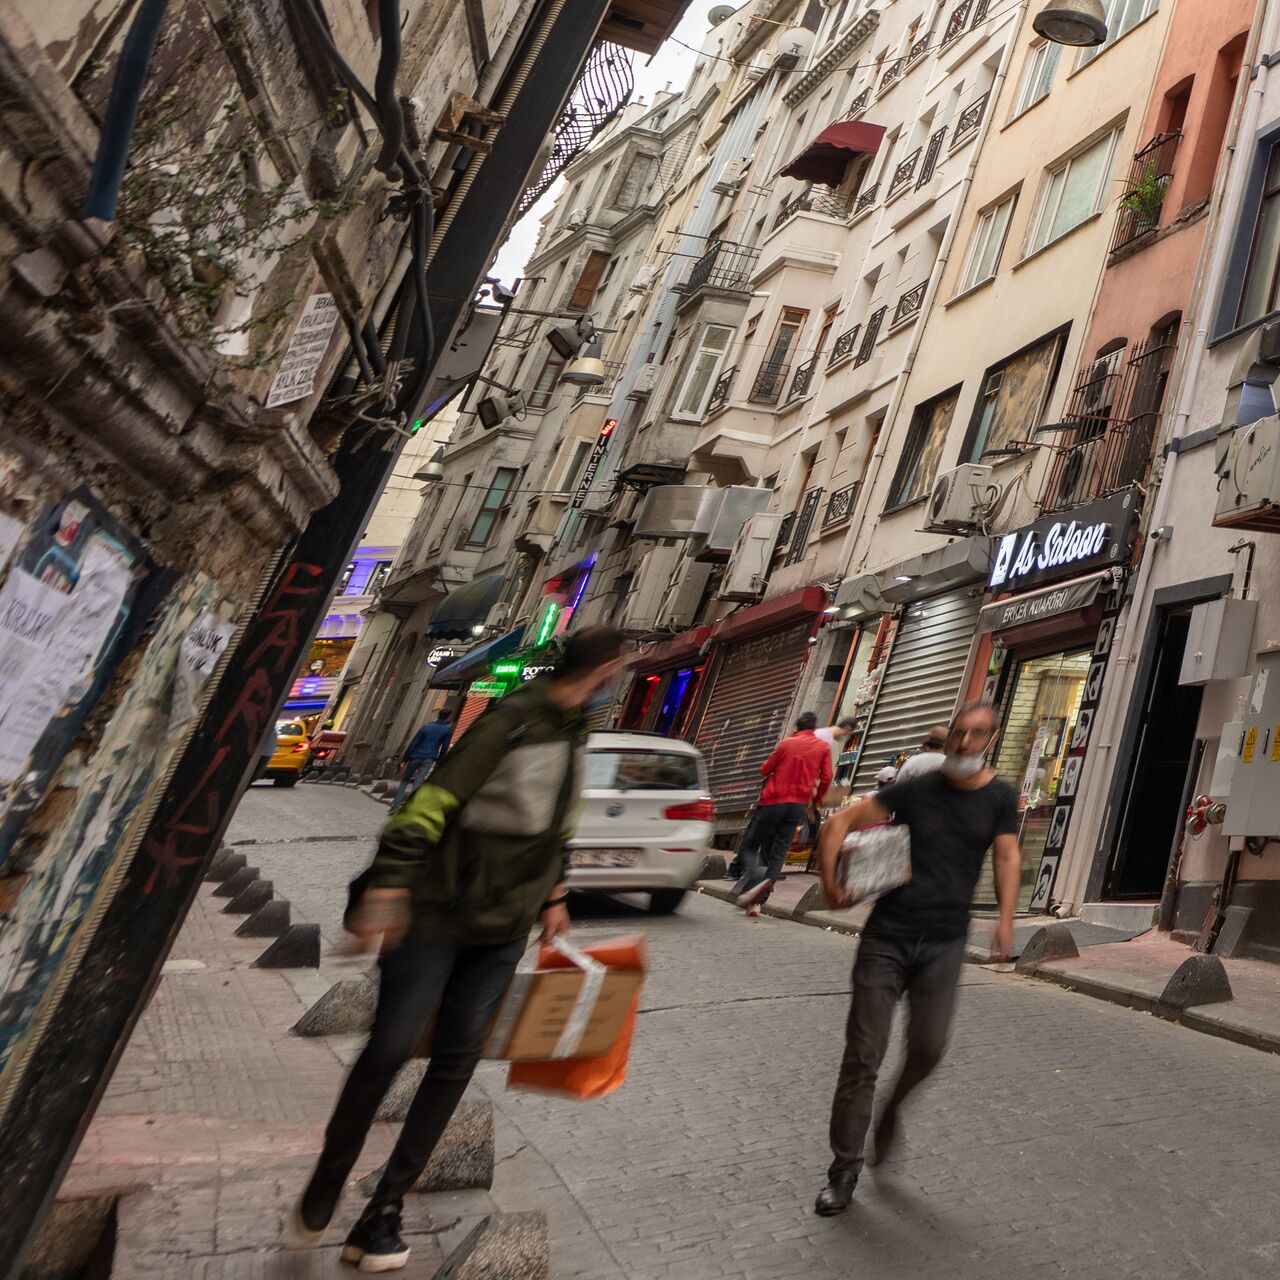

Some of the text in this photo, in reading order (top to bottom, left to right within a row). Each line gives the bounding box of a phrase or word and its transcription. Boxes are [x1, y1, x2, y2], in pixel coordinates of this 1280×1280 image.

[575, 435, 606, 507] INTERNET
[1037, 520, 1107, 570] Saloon
[1002, 601, 1030, 623] ERKEK
